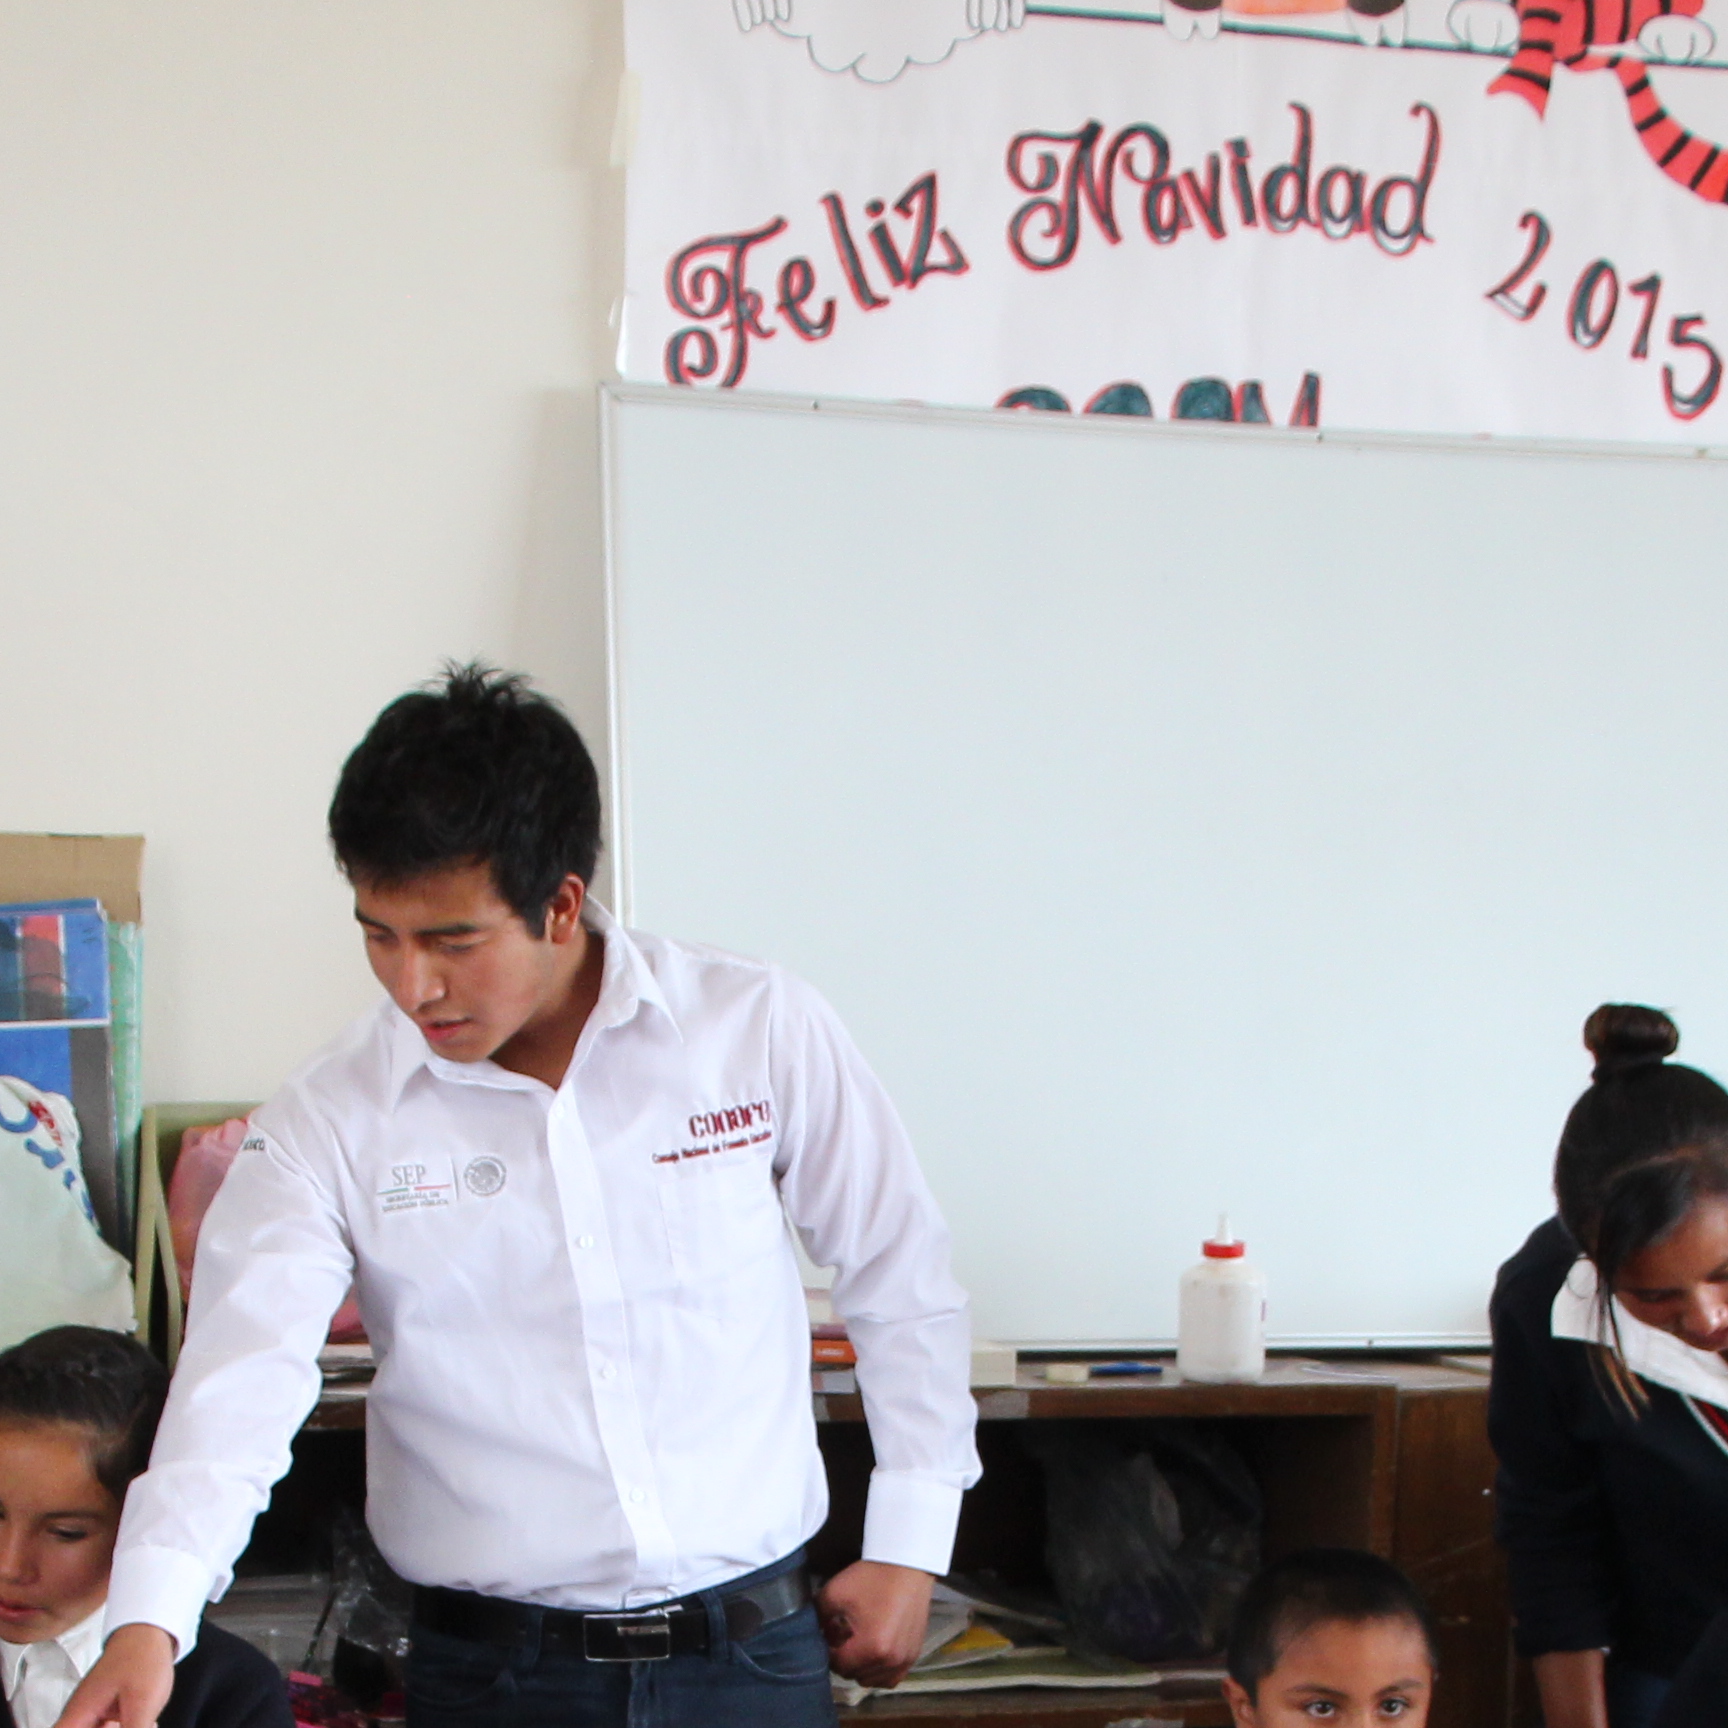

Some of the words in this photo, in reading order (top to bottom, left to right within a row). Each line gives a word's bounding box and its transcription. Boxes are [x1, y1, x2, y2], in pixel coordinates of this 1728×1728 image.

[663, 169, 971, 389] Feliz
[1006, 101, 1440, 271] Navidad
[1485, 210, 1723, 419] 2015
[391, 1164, 426, 1185] SEP
